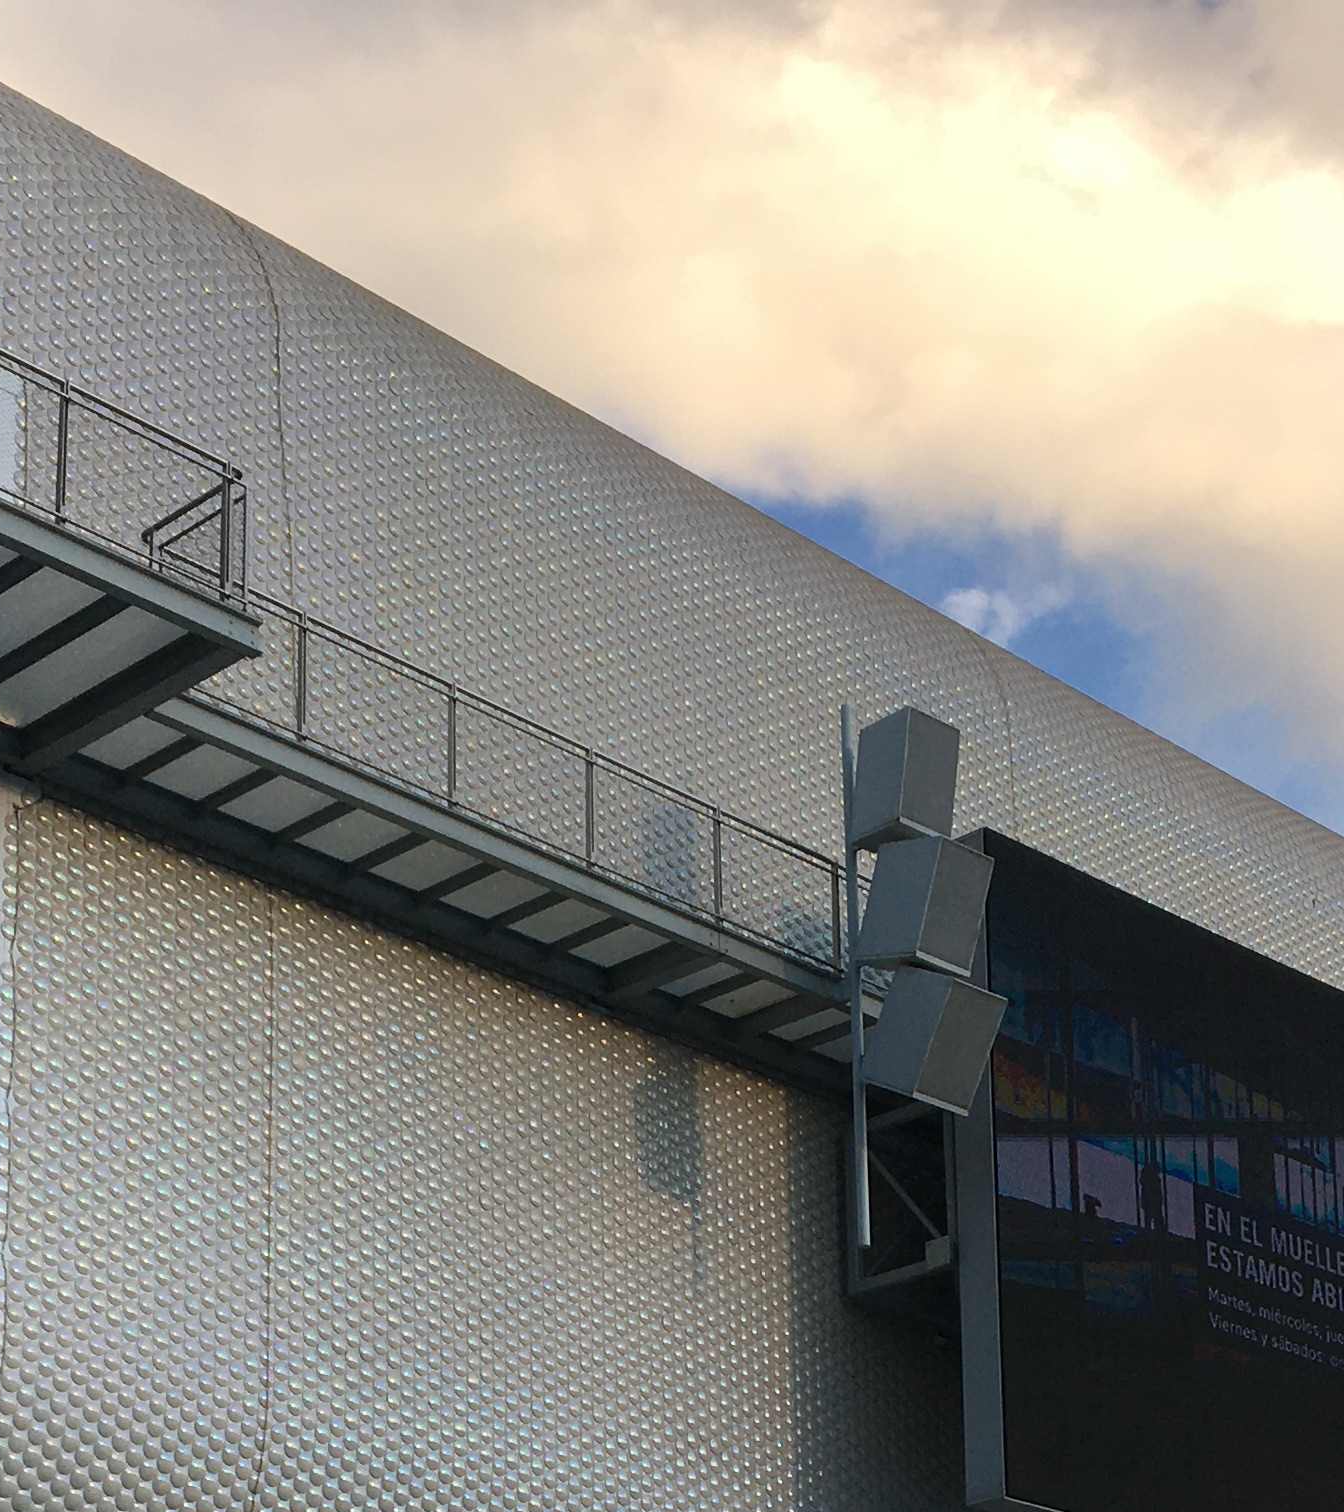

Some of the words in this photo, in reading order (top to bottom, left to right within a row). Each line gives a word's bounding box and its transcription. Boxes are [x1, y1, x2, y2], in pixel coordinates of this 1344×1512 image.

[1204, 1203, 1231, 1236] EN
[1240, 1216, 1263, 1247] EL
[1206, 1240, 1303, 1297] ESTAMOS
[1208, 1311, 1258, 1341] Viernes
